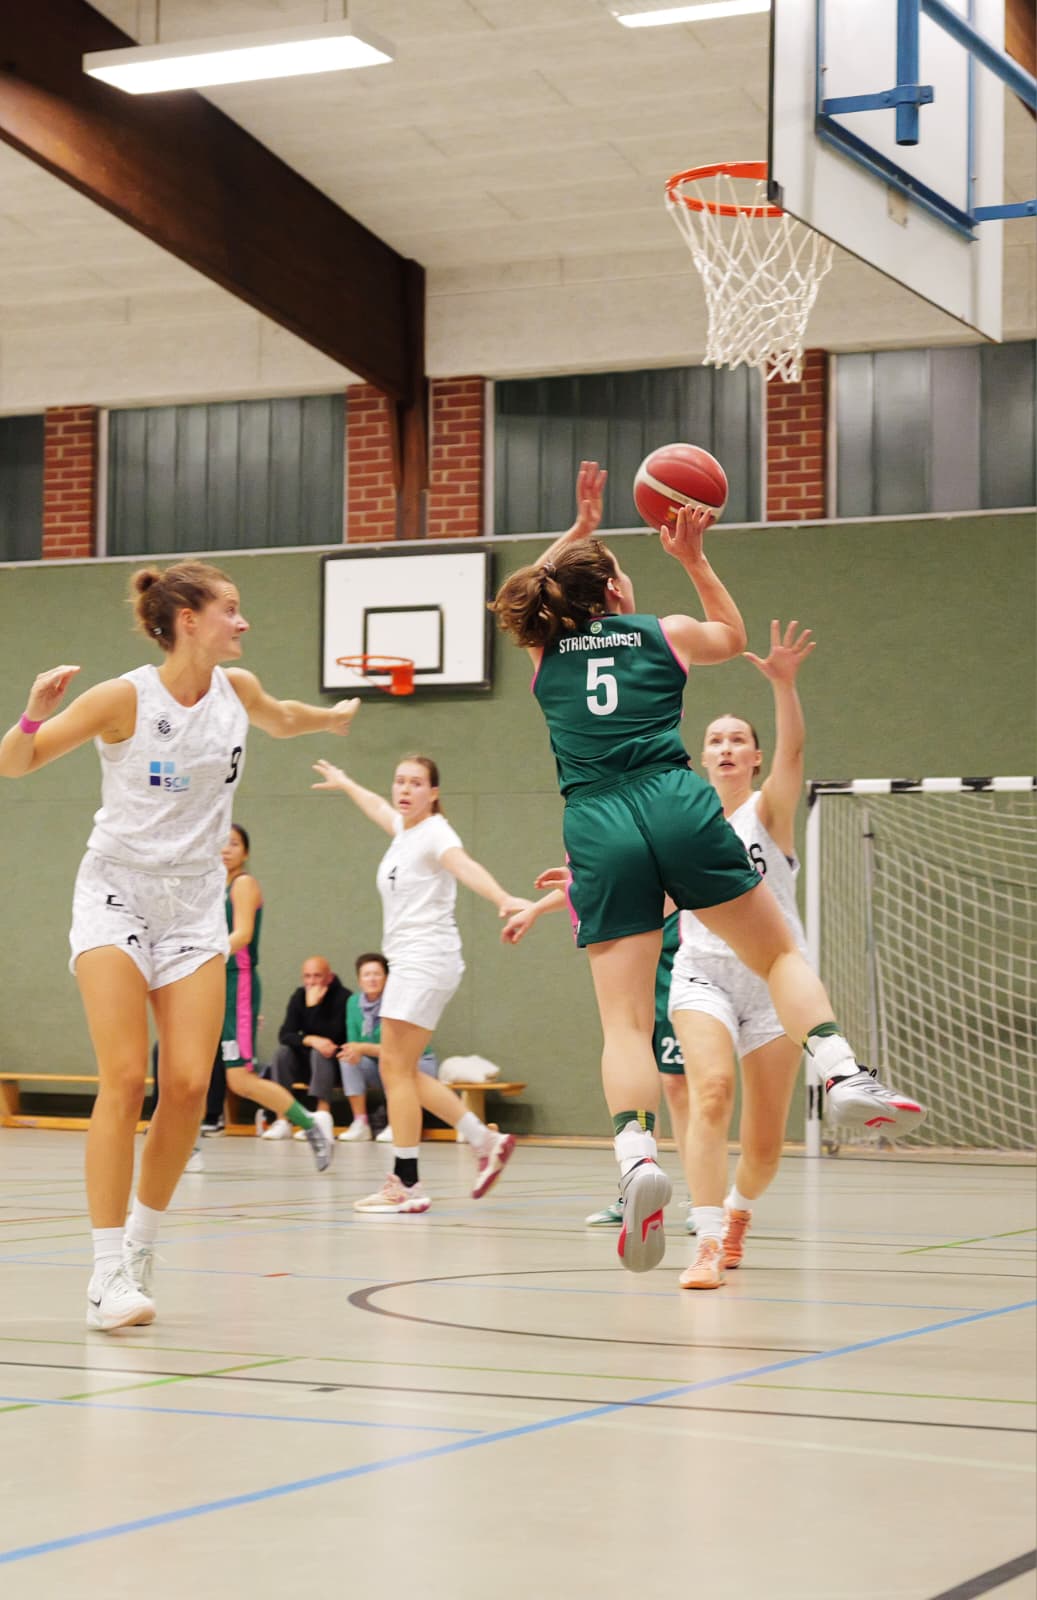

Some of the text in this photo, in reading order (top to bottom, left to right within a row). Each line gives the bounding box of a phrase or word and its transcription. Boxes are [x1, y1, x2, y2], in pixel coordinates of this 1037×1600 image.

[559, 632, 642, 654] STRICKHAUSEN
[586, 657, 618, 716] 5
[225, 746, 242, 784] 9
